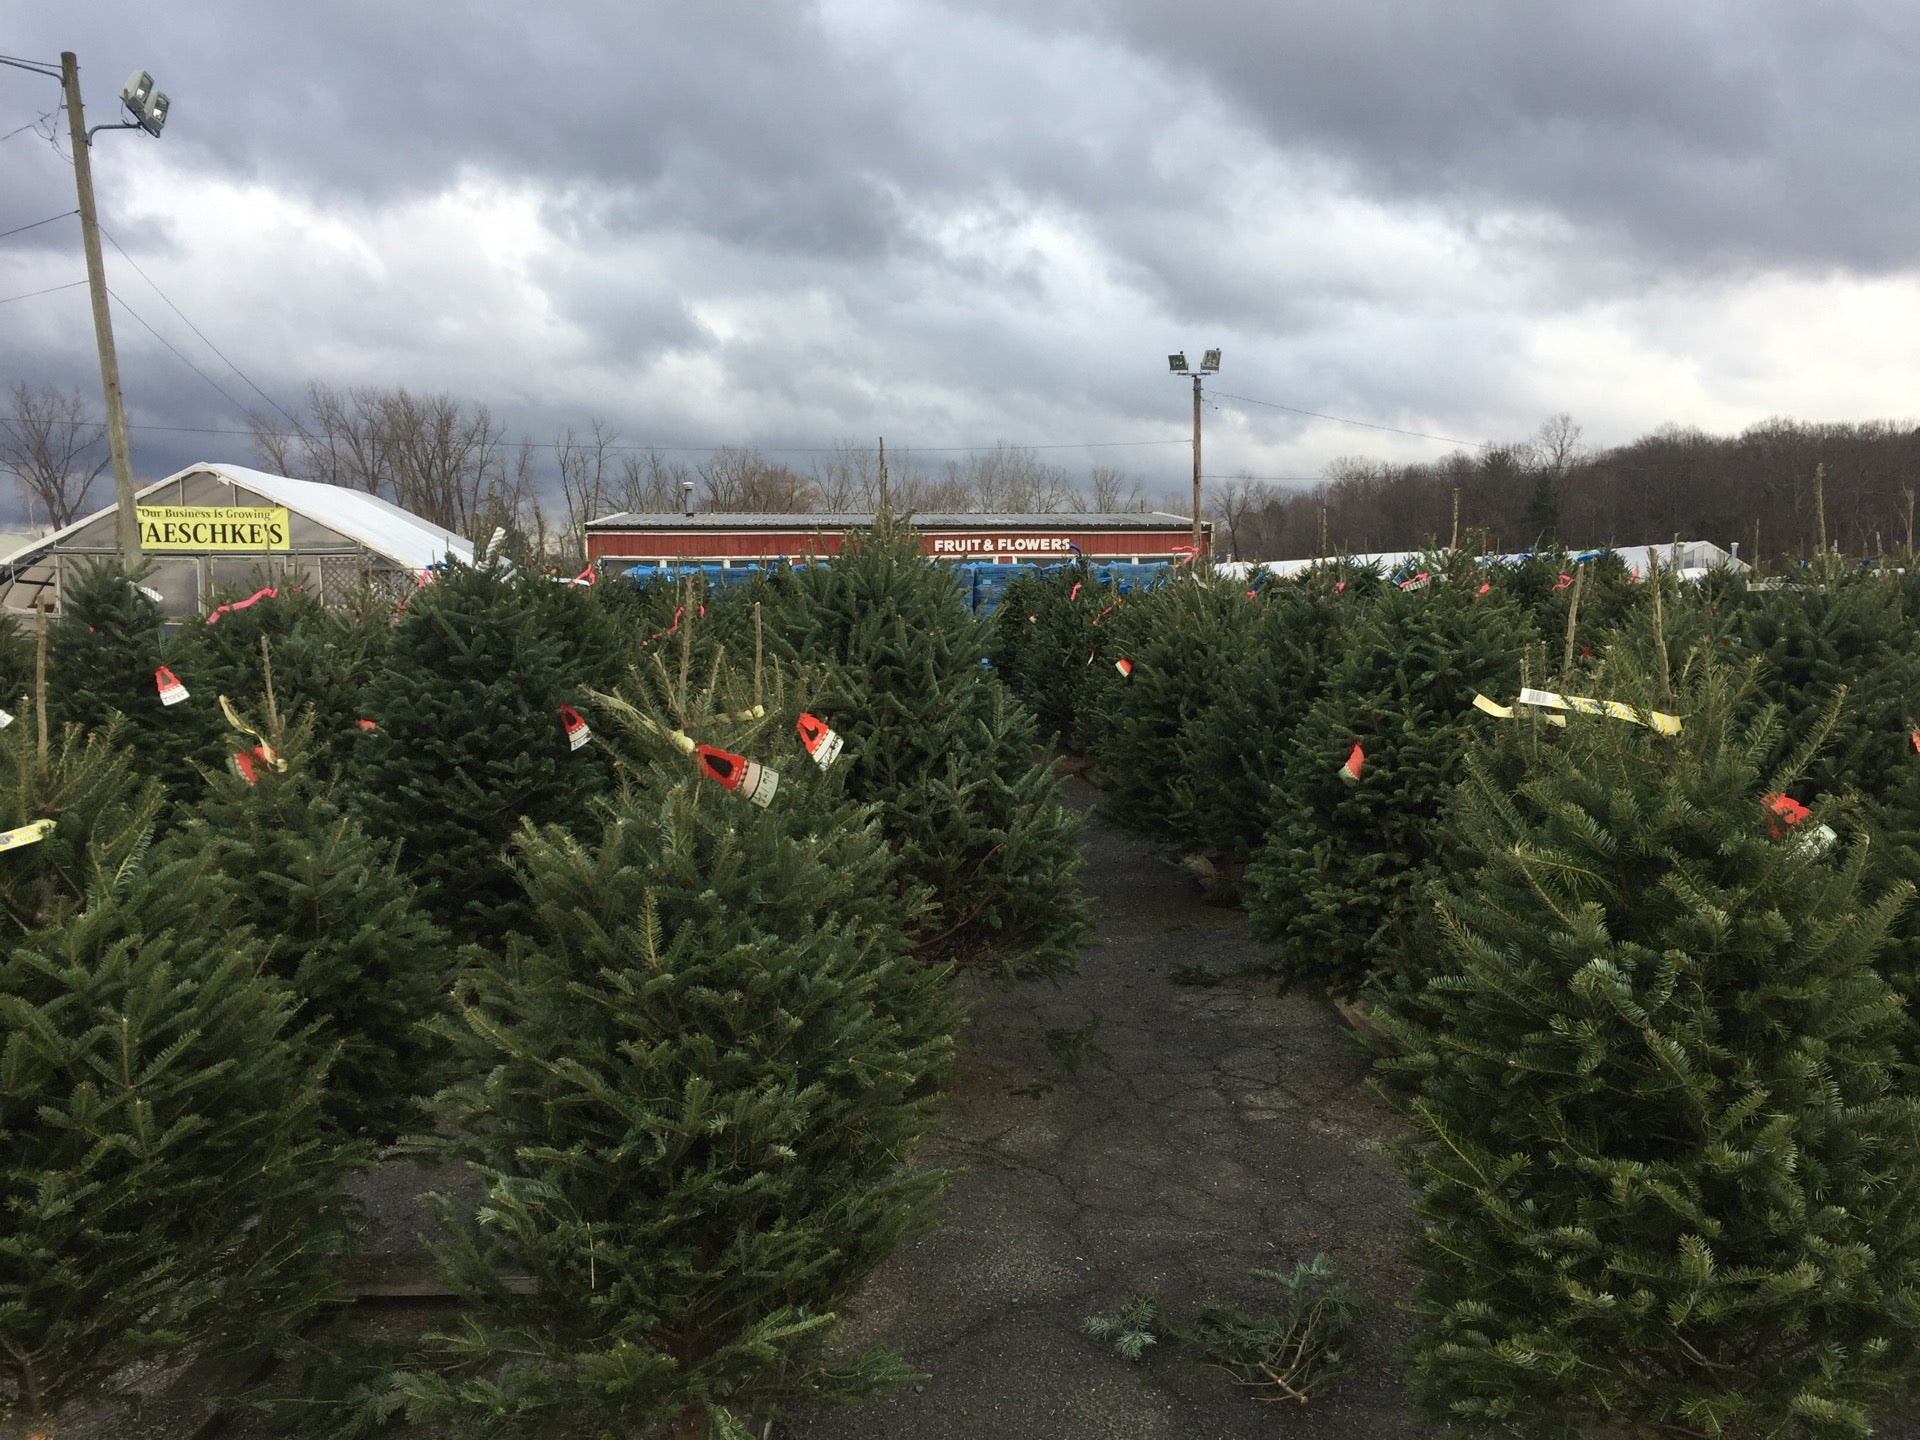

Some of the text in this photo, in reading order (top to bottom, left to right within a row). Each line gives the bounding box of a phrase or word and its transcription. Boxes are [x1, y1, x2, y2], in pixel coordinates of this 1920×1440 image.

[165, 508, 211, 518] Business
[214, 509, 223, 519] Is
[934, 538, 1070, 552] FRUIT & FLOWERS
